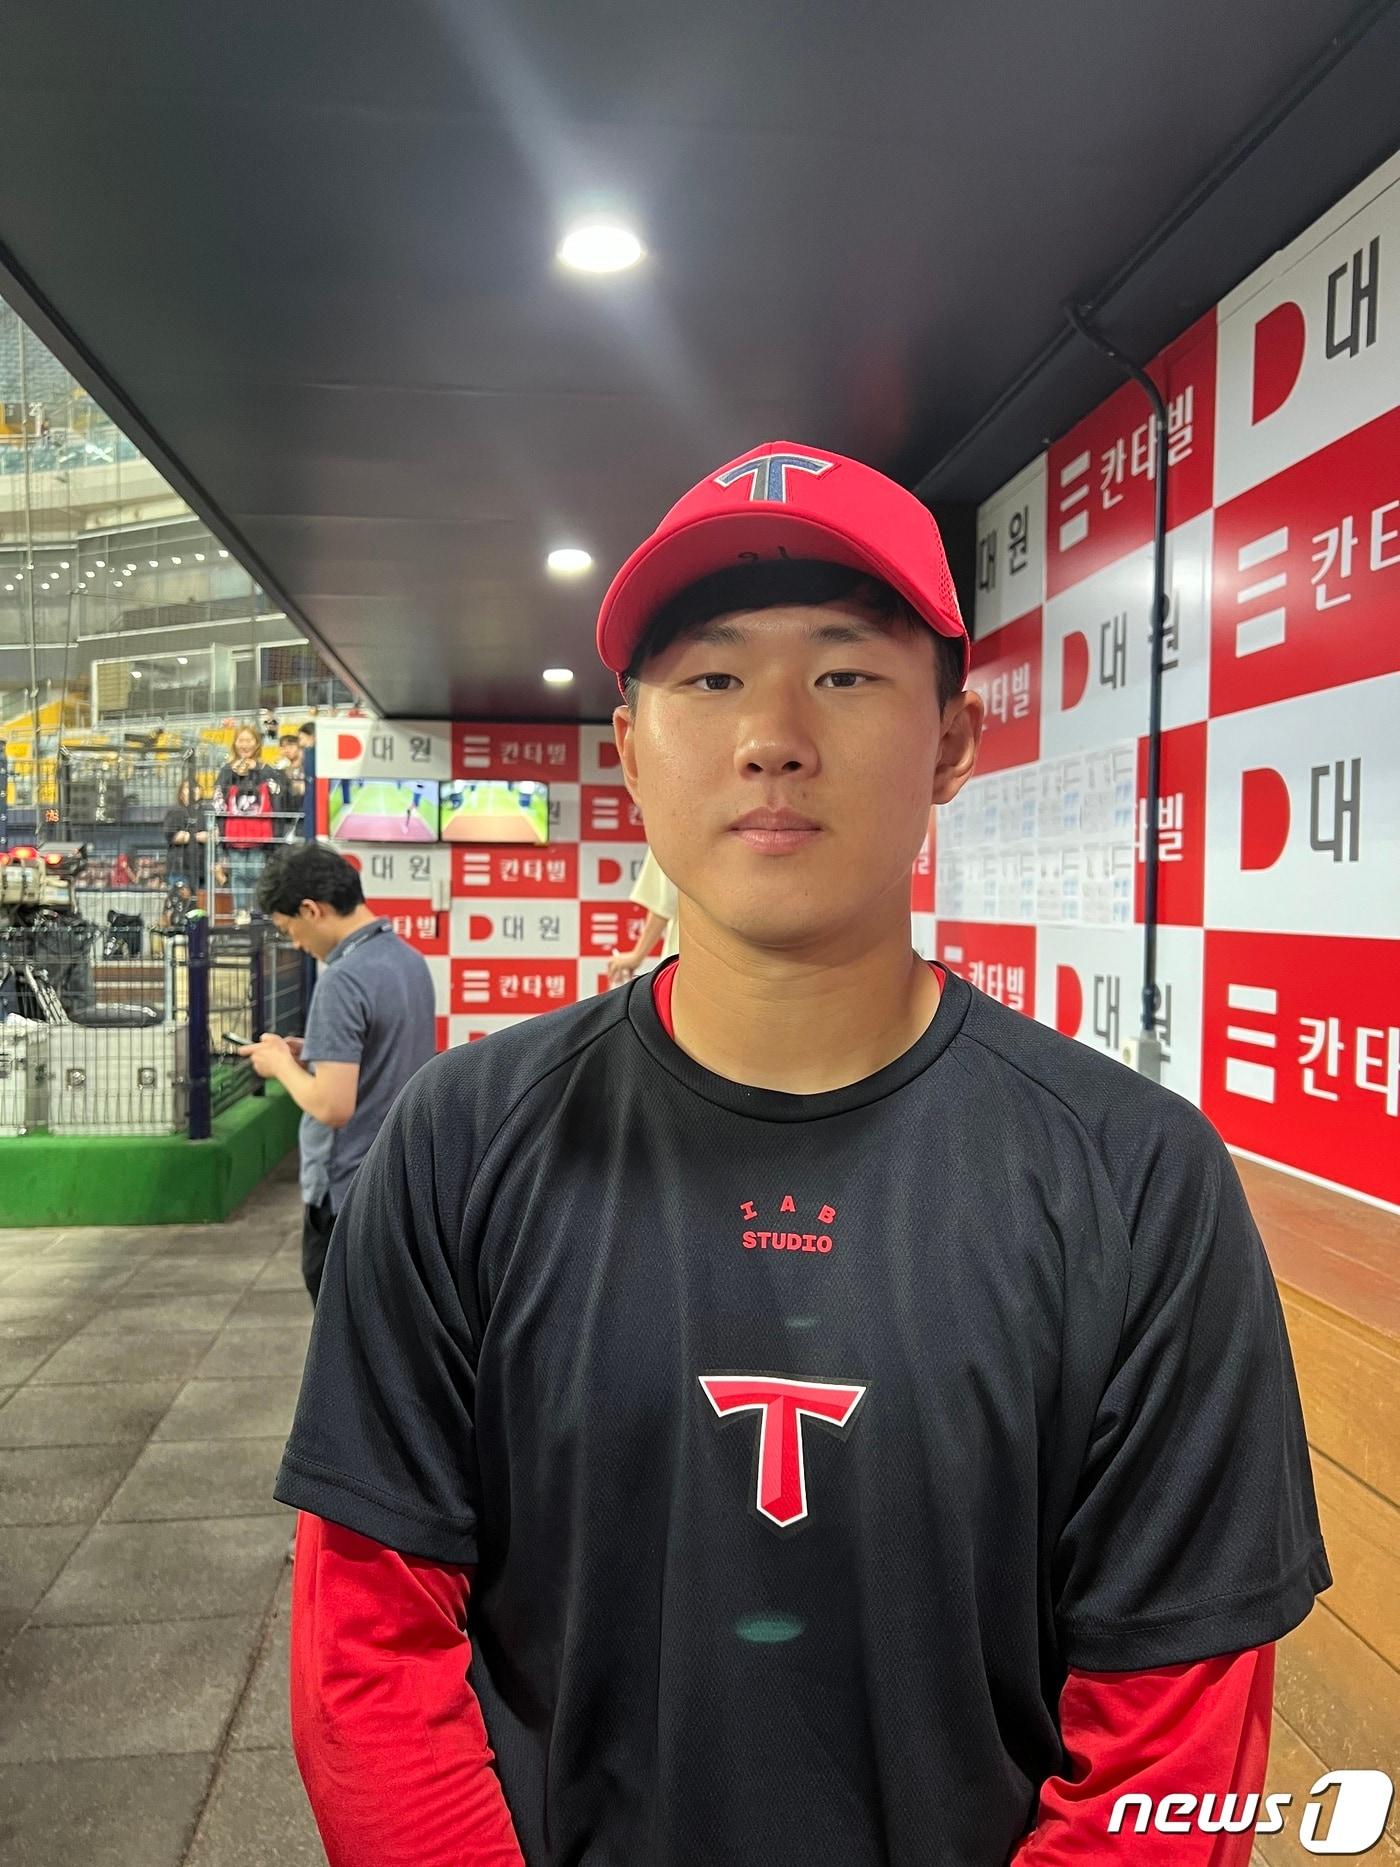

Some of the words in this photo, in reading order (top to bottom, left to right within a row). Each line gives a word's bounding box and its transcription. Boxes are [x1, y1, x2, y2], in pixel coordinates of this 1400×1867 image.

[1100, 385, 1194, 510] 칸타빌
[500, 858, 566, 883] 칸타빌
[500, 974, 565, 998] 칸타빌
[742, 1230, 833, 1254] STUDIO
[698, 1375, 867, 1528] T
